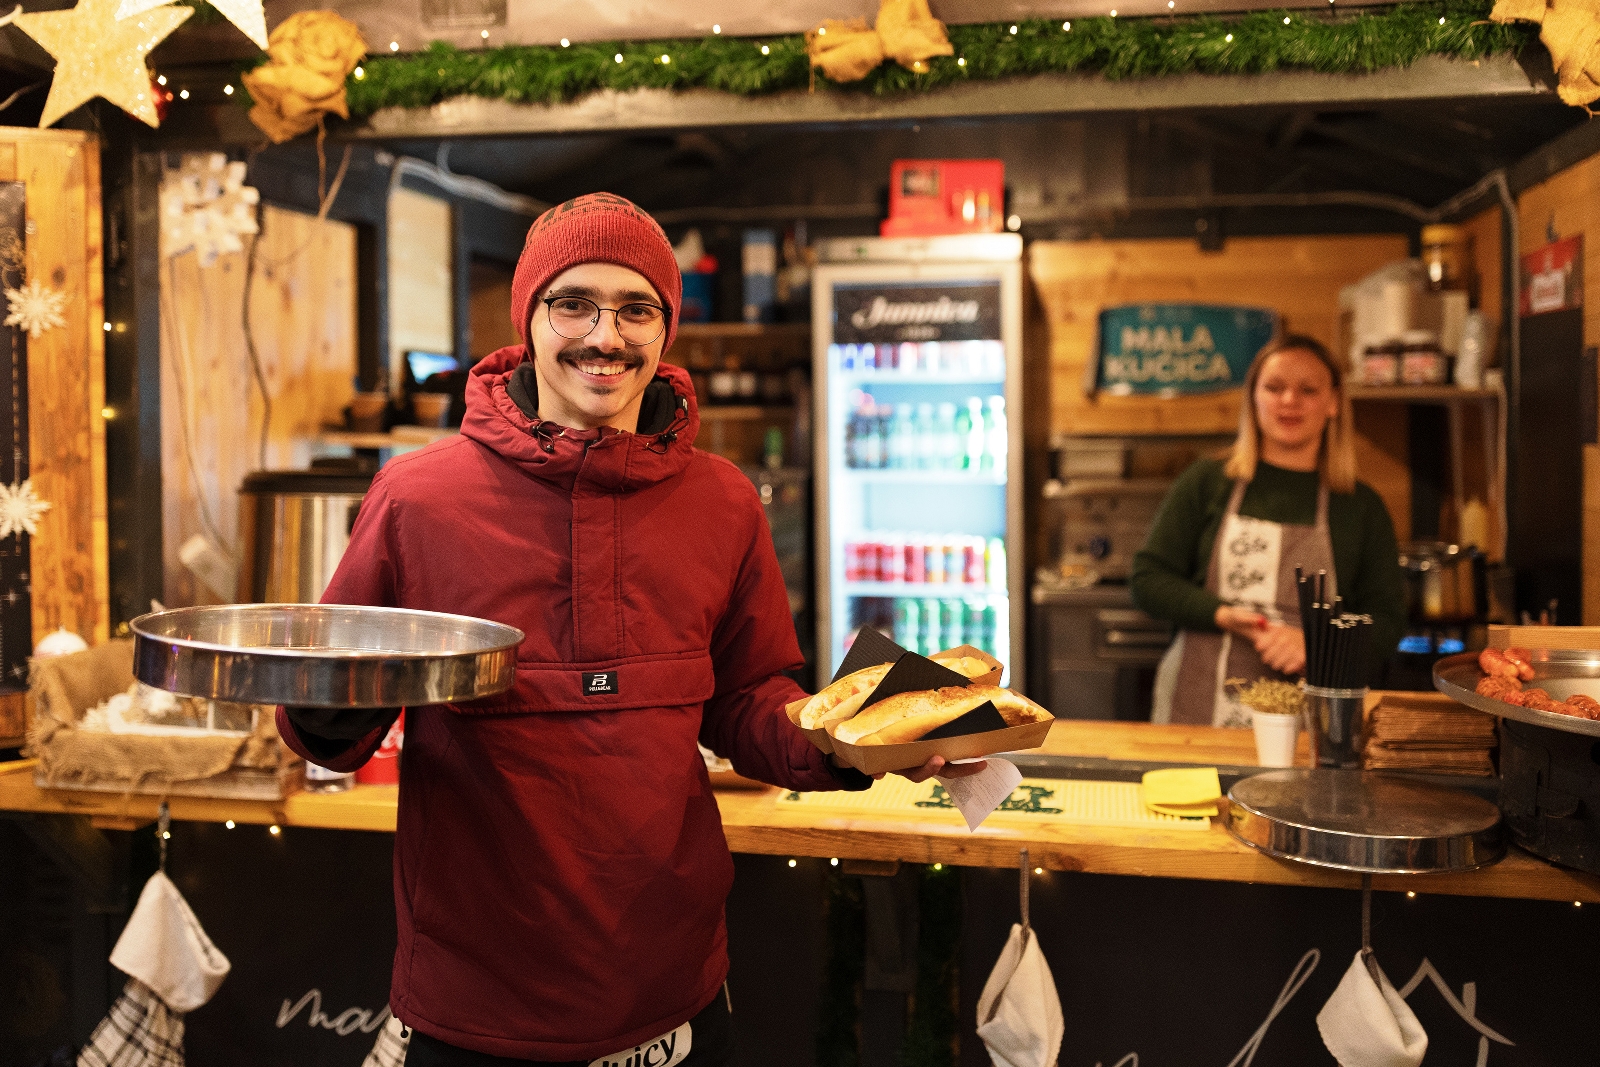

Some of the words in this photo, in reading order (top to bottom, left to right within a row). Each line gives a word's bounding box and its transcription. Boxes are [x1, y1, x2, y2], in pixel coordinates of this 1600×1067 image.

[1120, 325, 1215, 351] MALA
[276, 988, 391, 1036] ma
[602, 1031, 677, 1067] icy
